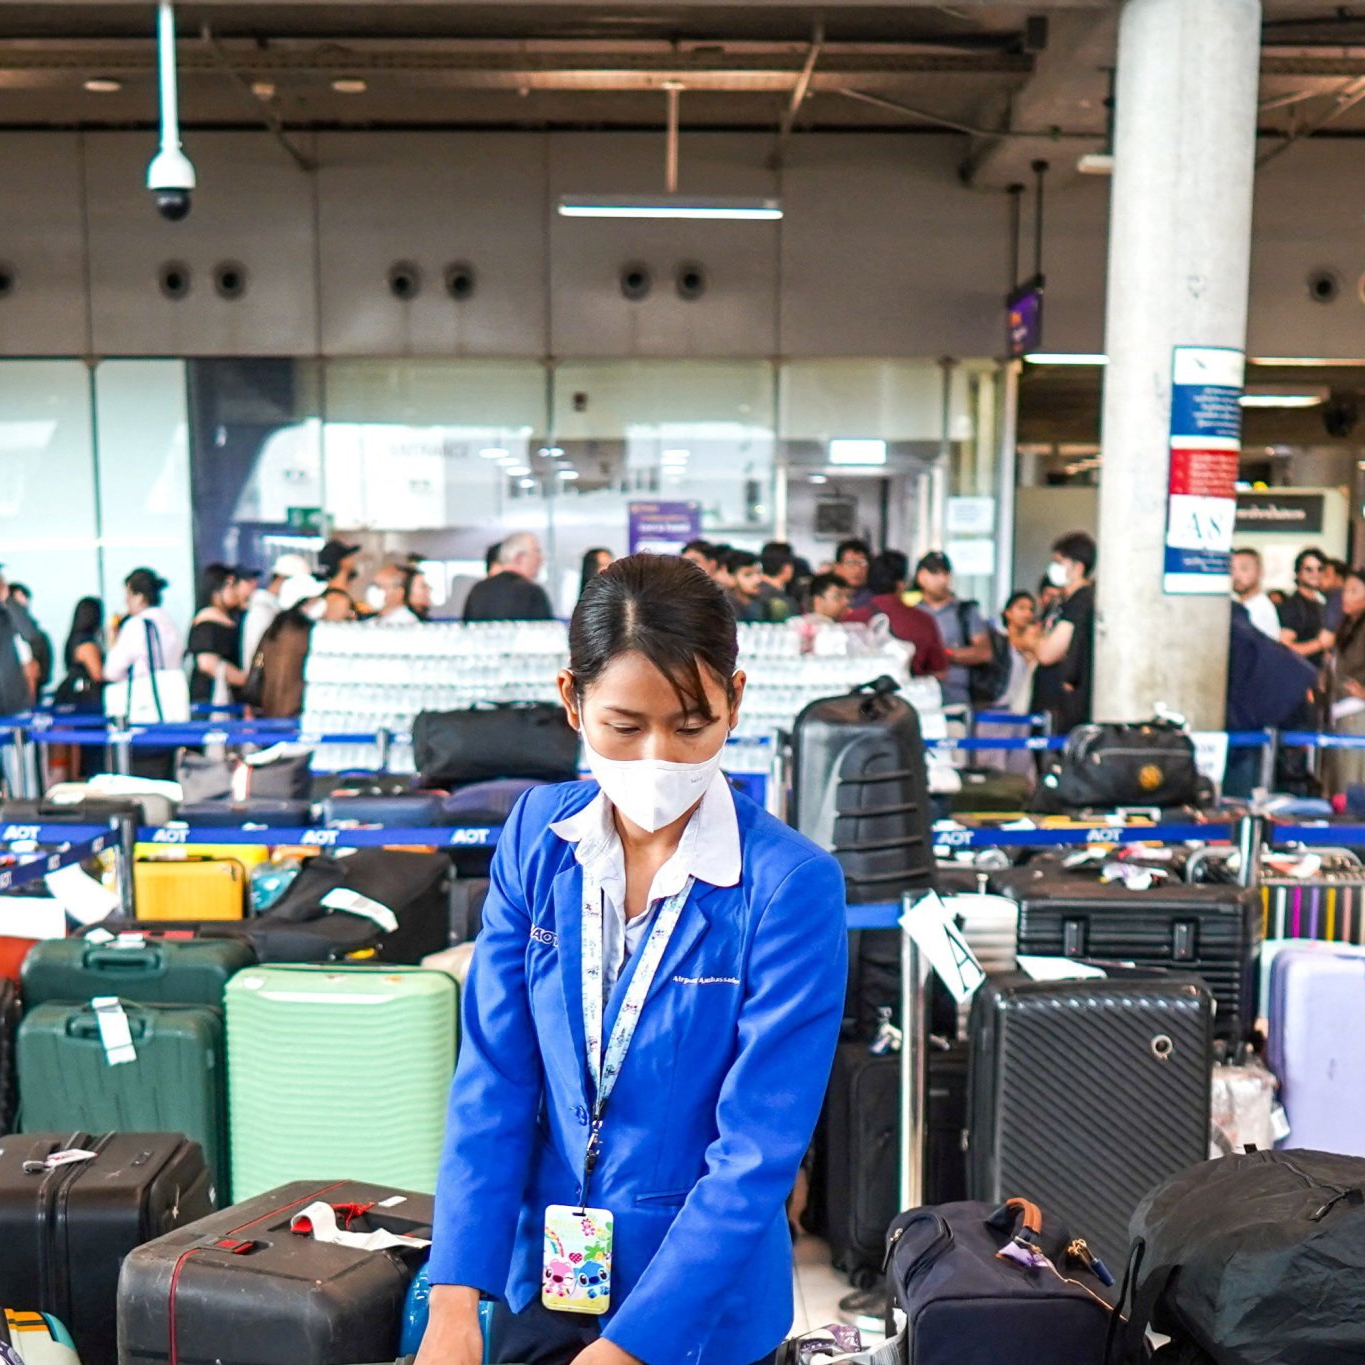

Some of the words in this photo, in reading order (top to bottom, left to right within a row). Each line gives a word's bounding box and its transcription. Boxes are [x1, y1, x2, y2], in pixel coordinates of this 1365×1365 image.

[3, 825, 42, 841] AOT
[152, 828, 191, 843] AOT
[300, 829, 339, 845] AOT
[450, 829, 490, 845] AOT
[936, 830, 975, 846] AOT
[1086, 828, 1123, 842] AOT
